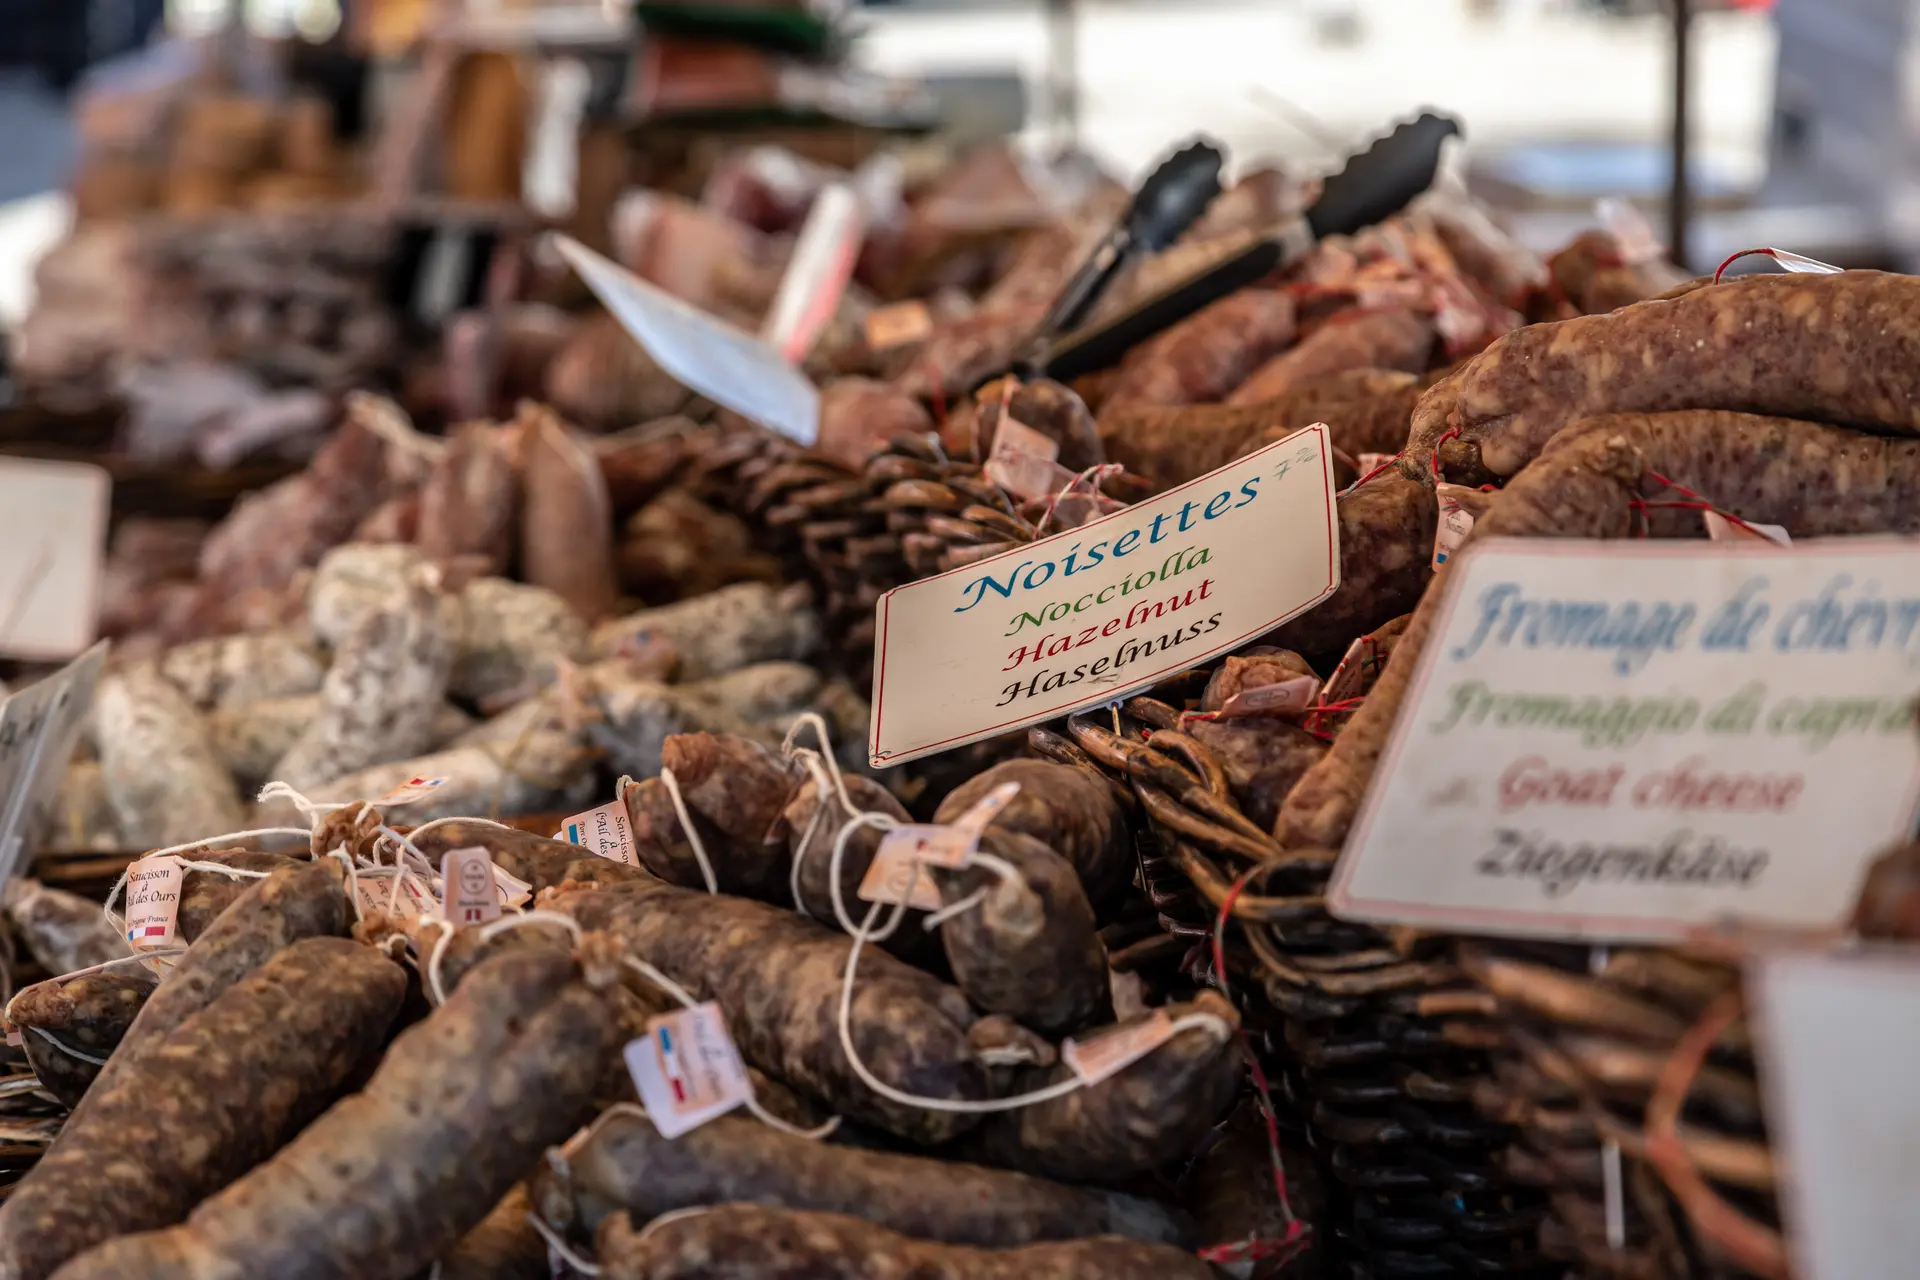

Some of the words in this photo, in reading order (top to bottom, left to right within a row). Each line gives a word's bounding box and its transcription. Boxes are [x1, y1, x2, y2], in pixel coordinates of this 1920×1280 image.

[954, 476, 1261, 613] Noisettes
[1002, 579, 1215, 672] Hazelnut
[1004, 545, 1213, 637] Nocciolla
[1451, 581, 1697, 675] Fromage
[1699, 575, 1770, 653] de
[996, 612, 1222, 707] Haselnuss
[1429, 678, 1701, 749] Fromaggio
[1703, 681, 1768, 736] di
[1498, 754, 1627, 814] Goat
[1631, 754, 1805, 814] cheese
[128, 868, 170, 883] Saucisson
[599, 838, 610, 855] des
[1475, 826, 1771, 896] Ziegenkäse
[136, 891, 149, 904] des
[150, 890, 176, 903] Ours
[141, 881, 148, 892] à
